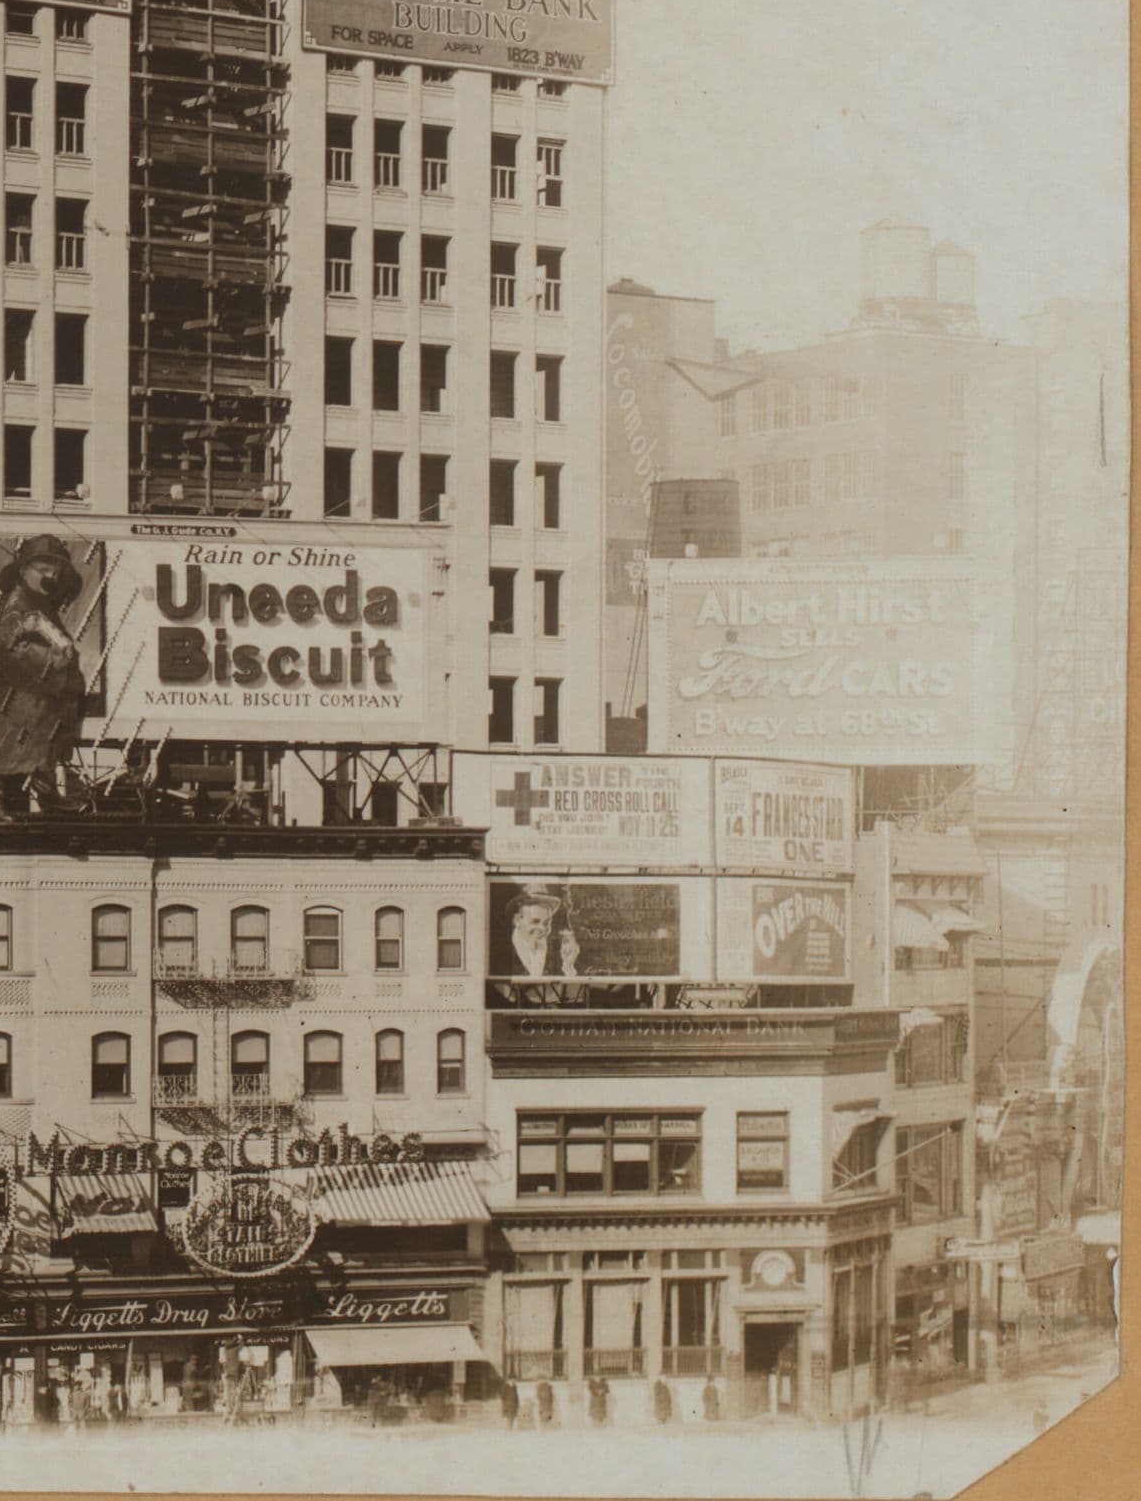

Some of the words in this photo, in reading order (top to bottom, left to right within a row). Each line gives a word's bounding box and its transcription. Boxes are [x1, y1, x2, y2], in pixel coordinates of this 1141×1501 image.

[390, 0, 530, 45] BUILDING
[331, 25, 362, 42] FOR
[368, 29, 414, 49] SPACE
[443, 41, 483, 55] APPLY
[506, 46, 539, 65] 1823
[544, 49, 587, 70] B'WAY
[183, 544, 243, 565] Rain
[252, 550, 281, 566] or
[287, 547, 356, 567] Shine
[156, 562, 400, 628] Uneeda
[695, 588, 822, 627] Albert
[836, 587, 942, 626] Hirst
[779, 629, 862, 649] SELLS
[158, 626, 395, 688] Biscuit
[678, 645, 841, 702] Ford
[840, 660, 955, 699] CARS
[144, 691, 234, 706] NATIONAL
[242, 692, 312, 707] BISCUIT
[320, 693, 404, 708] COMPANY
[695, 708, 786, 741] B'way
[794, 712, 828, 737] at
[841, 709, 902, 737] 68th
[907, 711, 941, 737] St
[539, 764, 633, 789] ANSWER
[554, 790, 579, 813] RED
[583, 790, 623, 813] CROSS
[625, 791, 650, 813] ROLL
[652, 791, 680, 814] CALL
[725, 816, 745, 837] 14
[783, 840, 825, 862] ONE
[756, 891, 805, 959] OVER
[519, 1018, 619, 1037] GOTHAM
[629, 1017, 733, 1037] NATIONAL
[745, 1016, 809, 1037] BANK
[25, 1130, 227, 1176] Monroe
[237, 1121, 425, 1170] Clothes
[150, 1299, 209, 1327] Drug
[218, 1297, 284, 1323] Store
